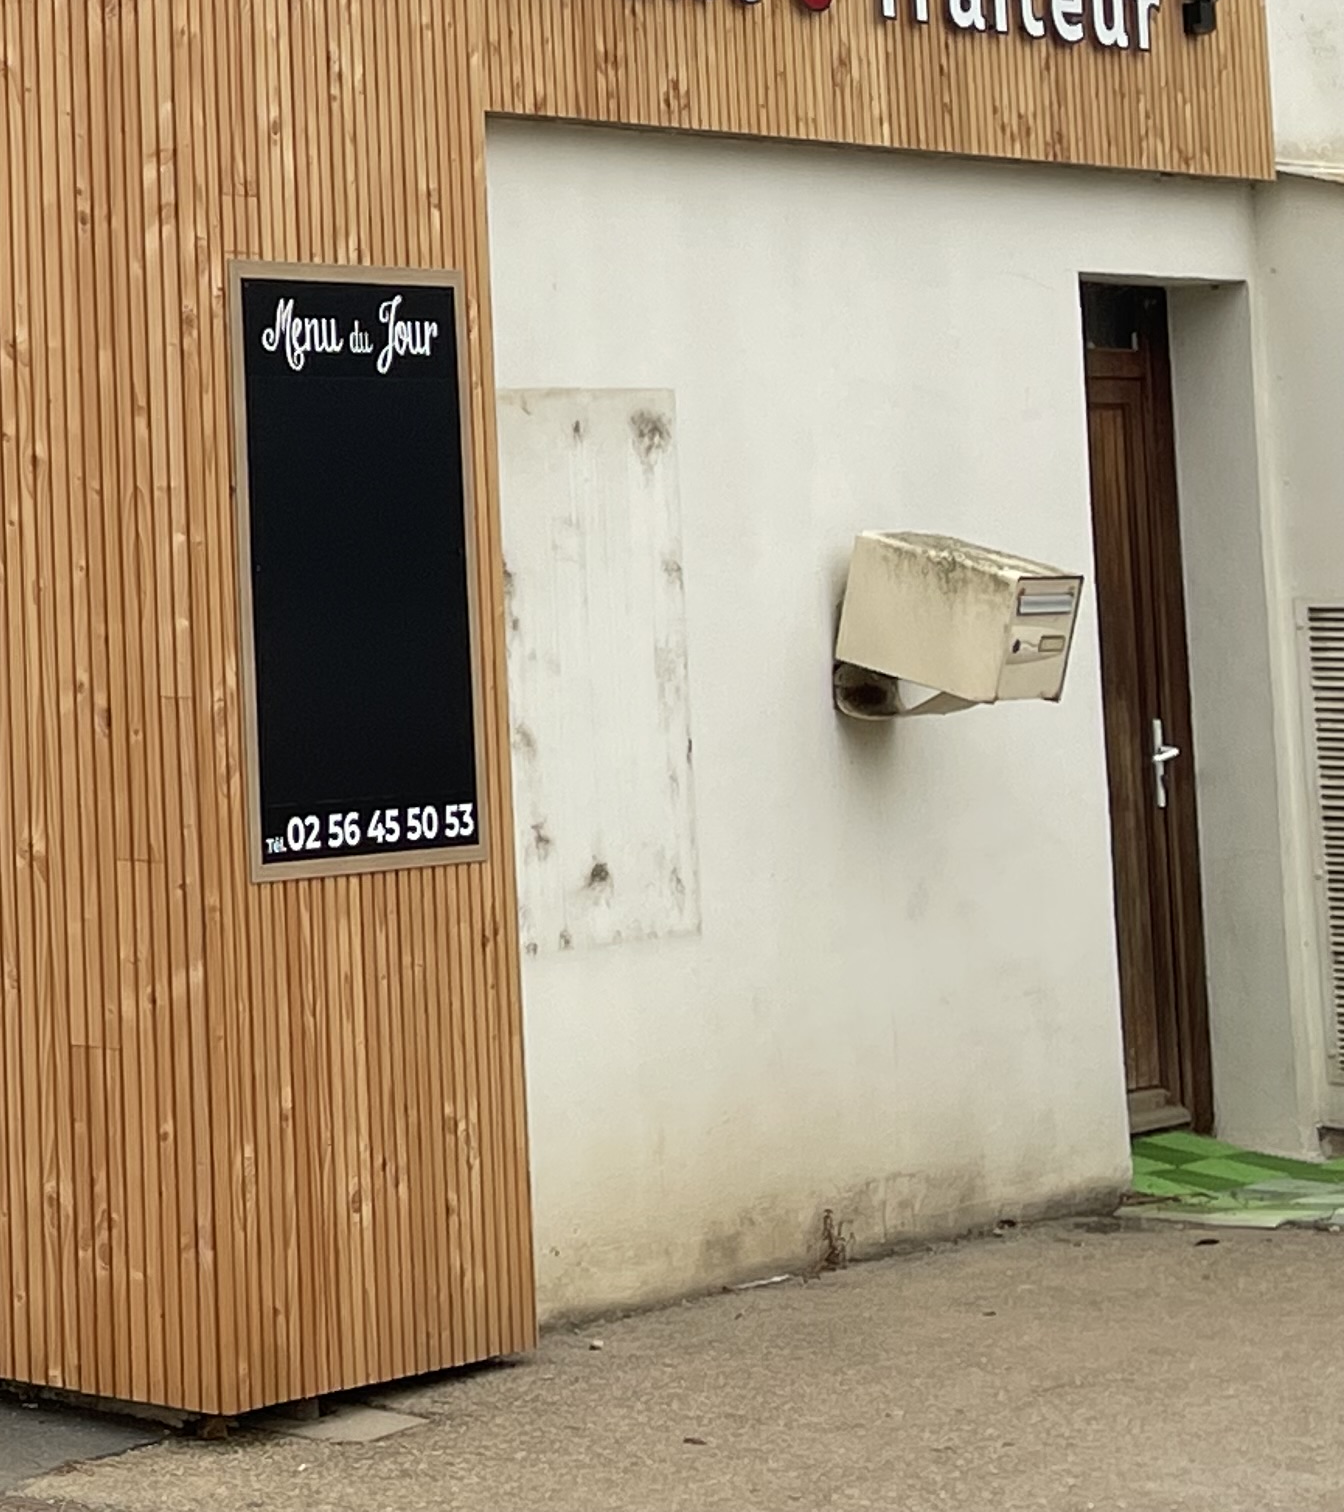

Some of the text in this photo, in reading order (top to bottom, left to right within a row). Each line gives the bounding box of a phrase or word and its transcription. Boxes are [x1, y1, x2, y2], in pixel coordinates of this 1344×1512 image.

[262, 294, 438, 374] Menu du Jour
[287, 815, 321, 852] 02
[327, 811, 361, 848] 56
[367, 808, 400, 843] 45
[407, 805, 438, 841] 50
[445, 802, 475, 837] 53
